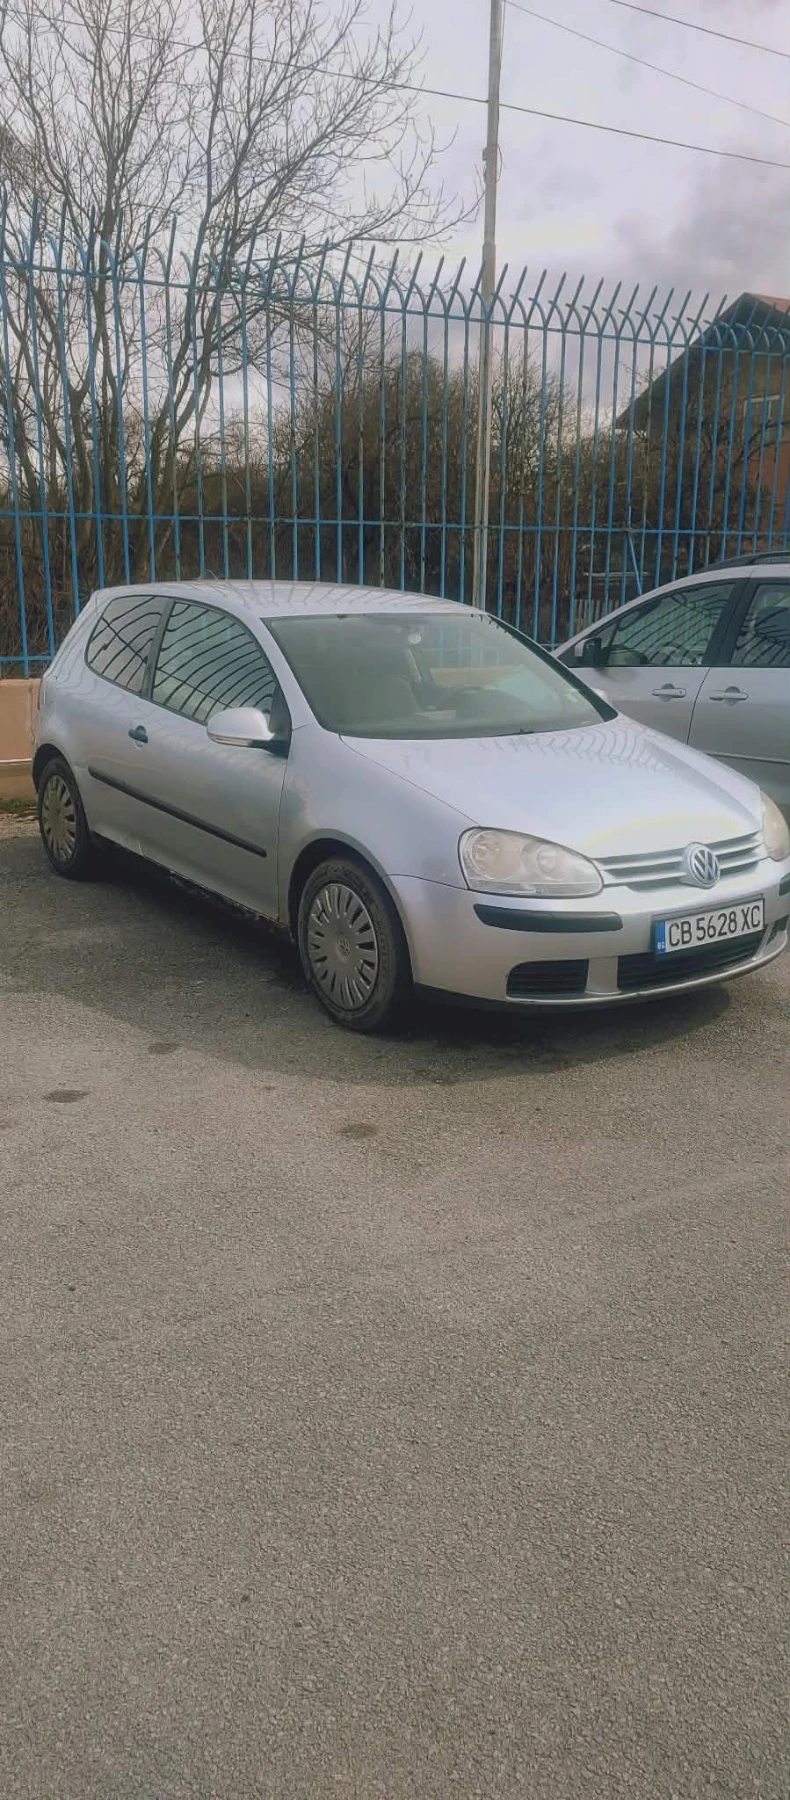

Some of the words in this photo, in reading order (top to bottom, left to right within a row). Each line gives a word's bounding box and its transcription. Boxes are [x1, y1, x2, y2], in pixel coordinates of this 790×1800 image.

[692, 847, 718, 884] VW
[669, 921, 692, 947] CB
[696, 911, 737, 941] 5628
[741, 905, 760, 931] XC
